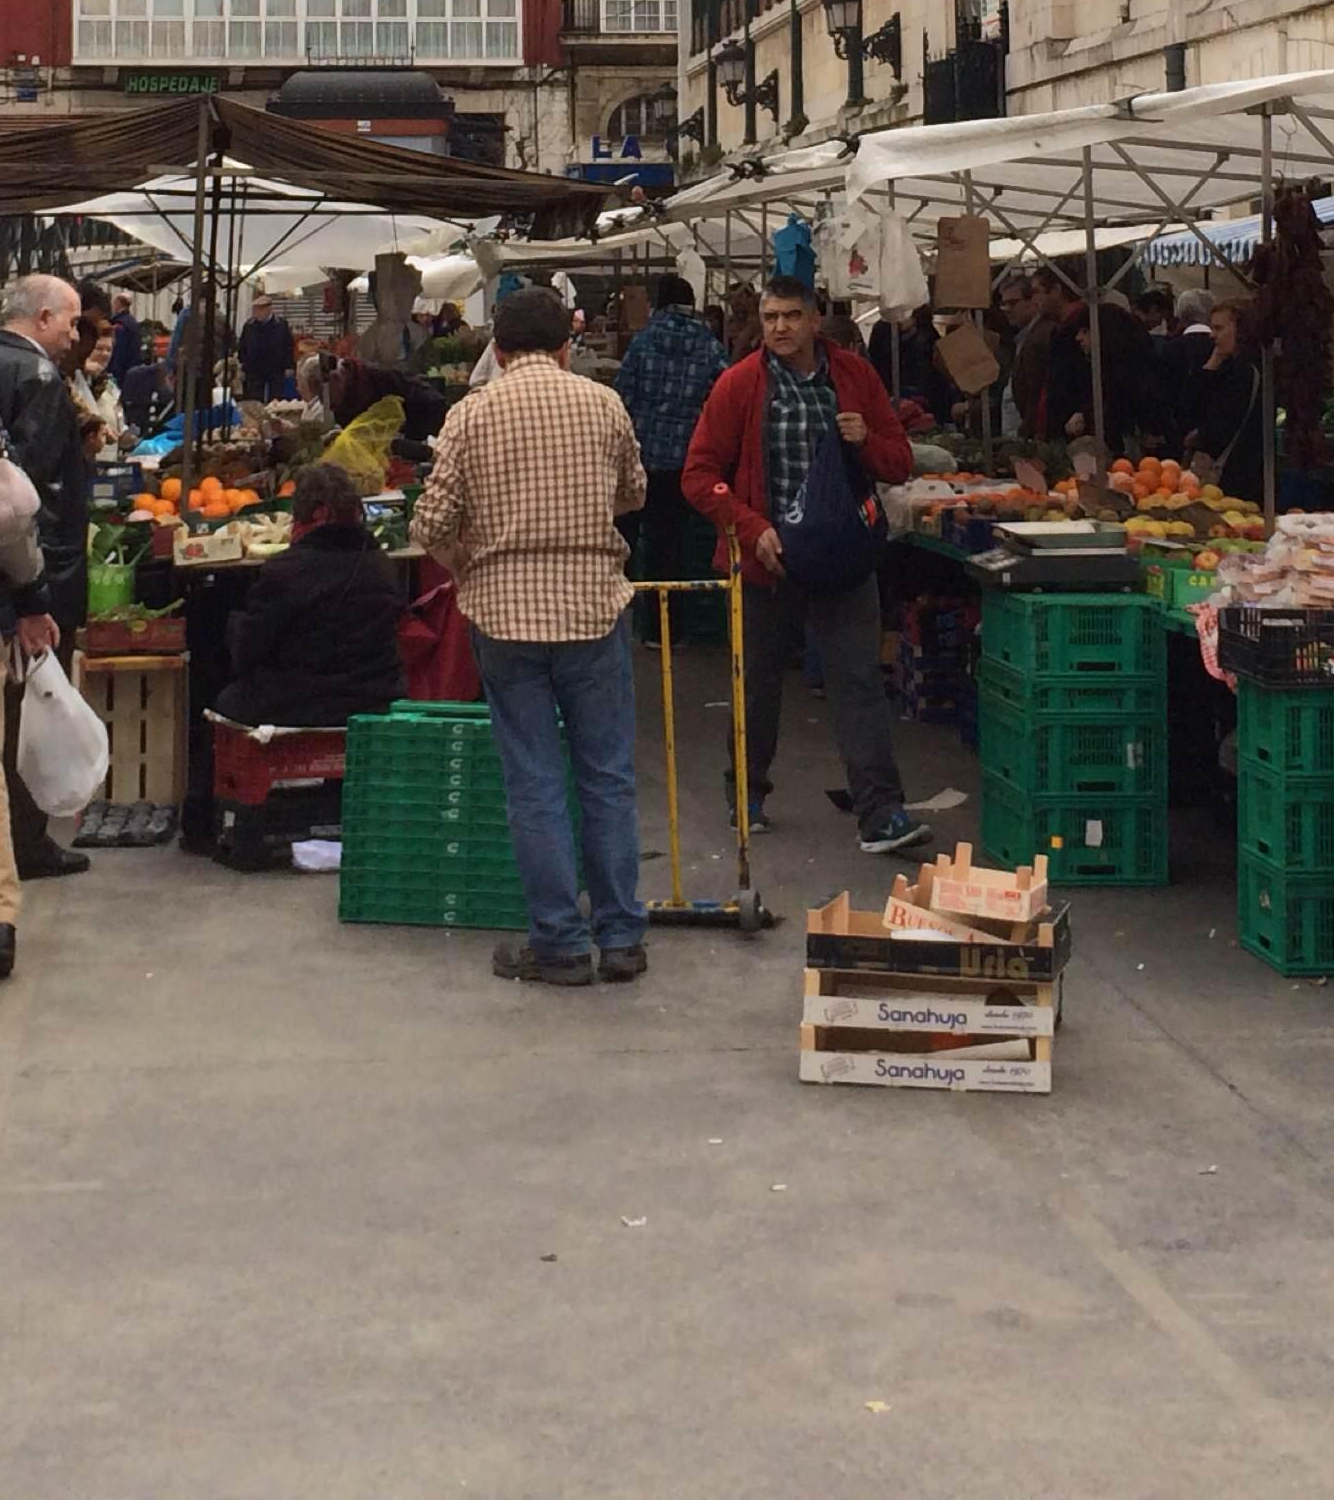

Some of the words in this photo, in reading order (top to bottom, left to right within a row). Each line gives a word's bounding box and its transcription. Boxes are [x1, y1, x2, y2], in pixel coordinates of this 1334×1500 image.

[128, 76, 217, 92] HOSPEDAJE
[877, 1003, 968, 1029] Sanahuja
[875, 1058, 965, 1085] Sanahuja
